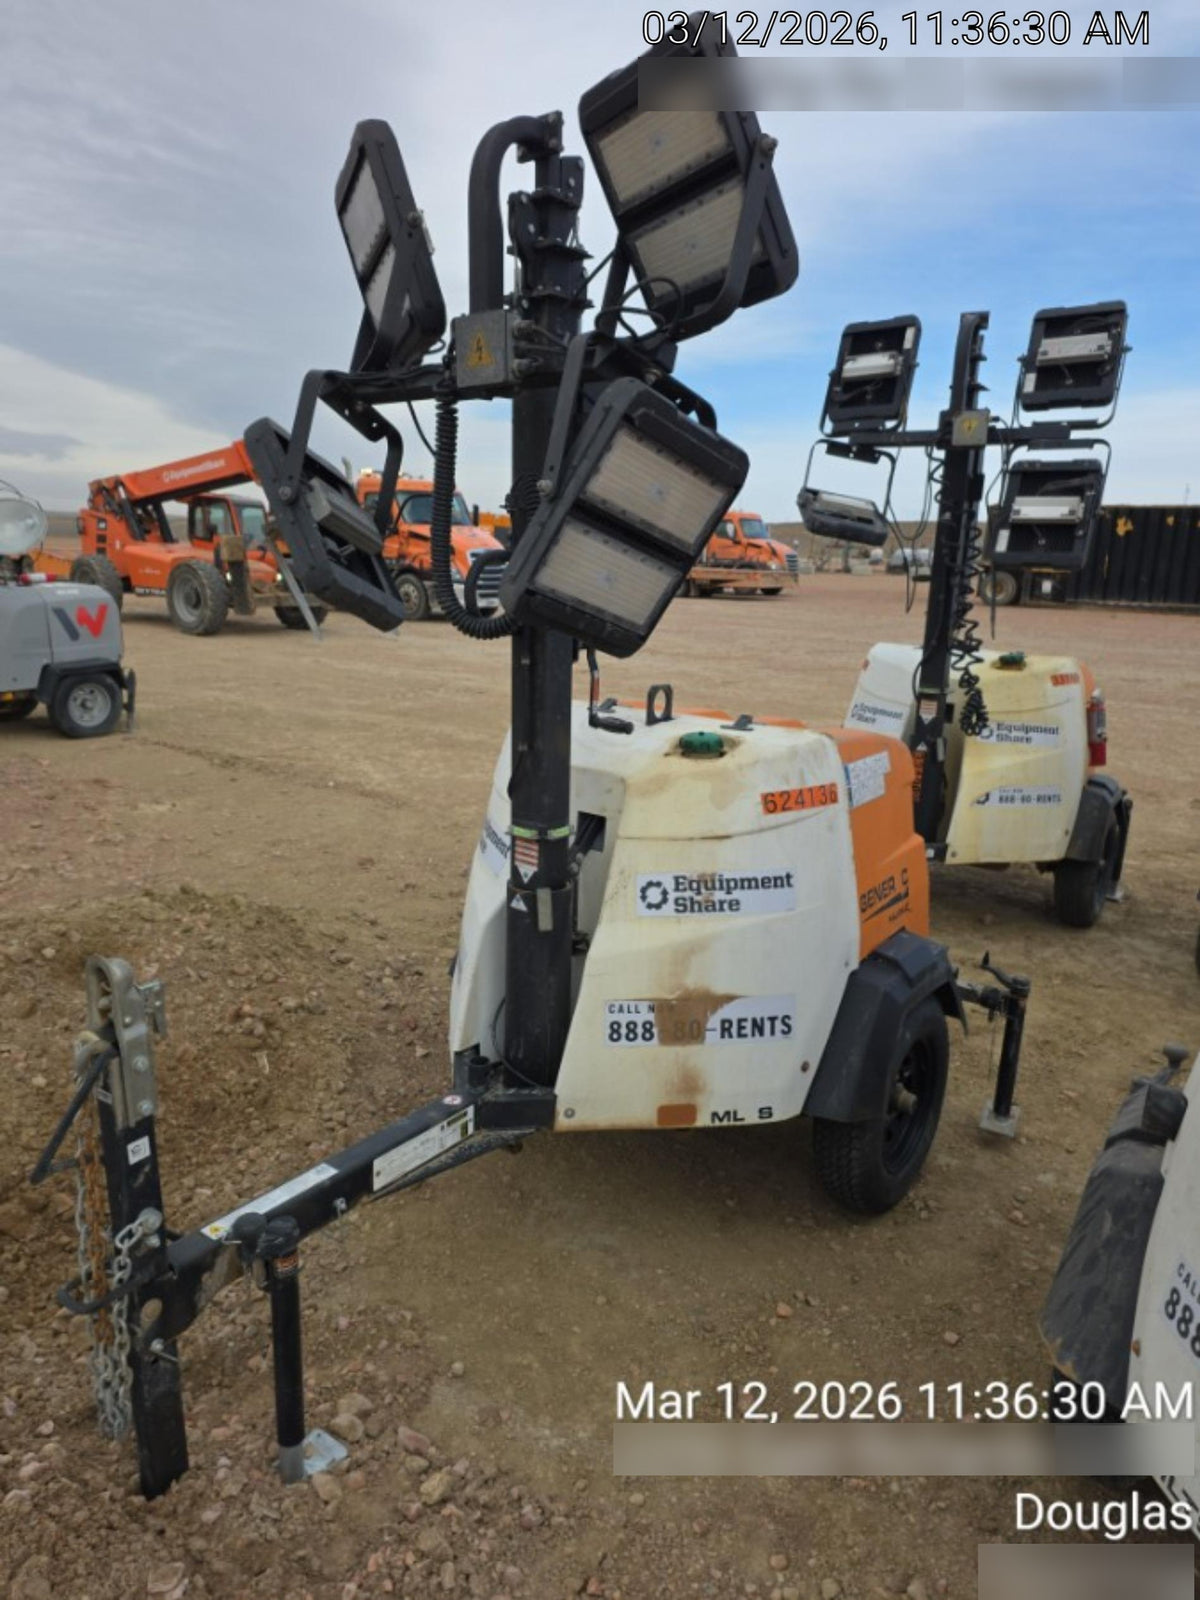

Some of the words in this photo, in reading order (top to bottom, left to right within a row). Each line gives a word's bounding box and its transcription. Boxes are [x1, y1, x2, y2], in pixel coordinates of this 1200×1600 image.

[763, 782, 838, 814] 624136
[672, 871, 794, 896] Equipment
[673, 895, 741, 914] Share
[608, 1003, 641, 1015] CALL
